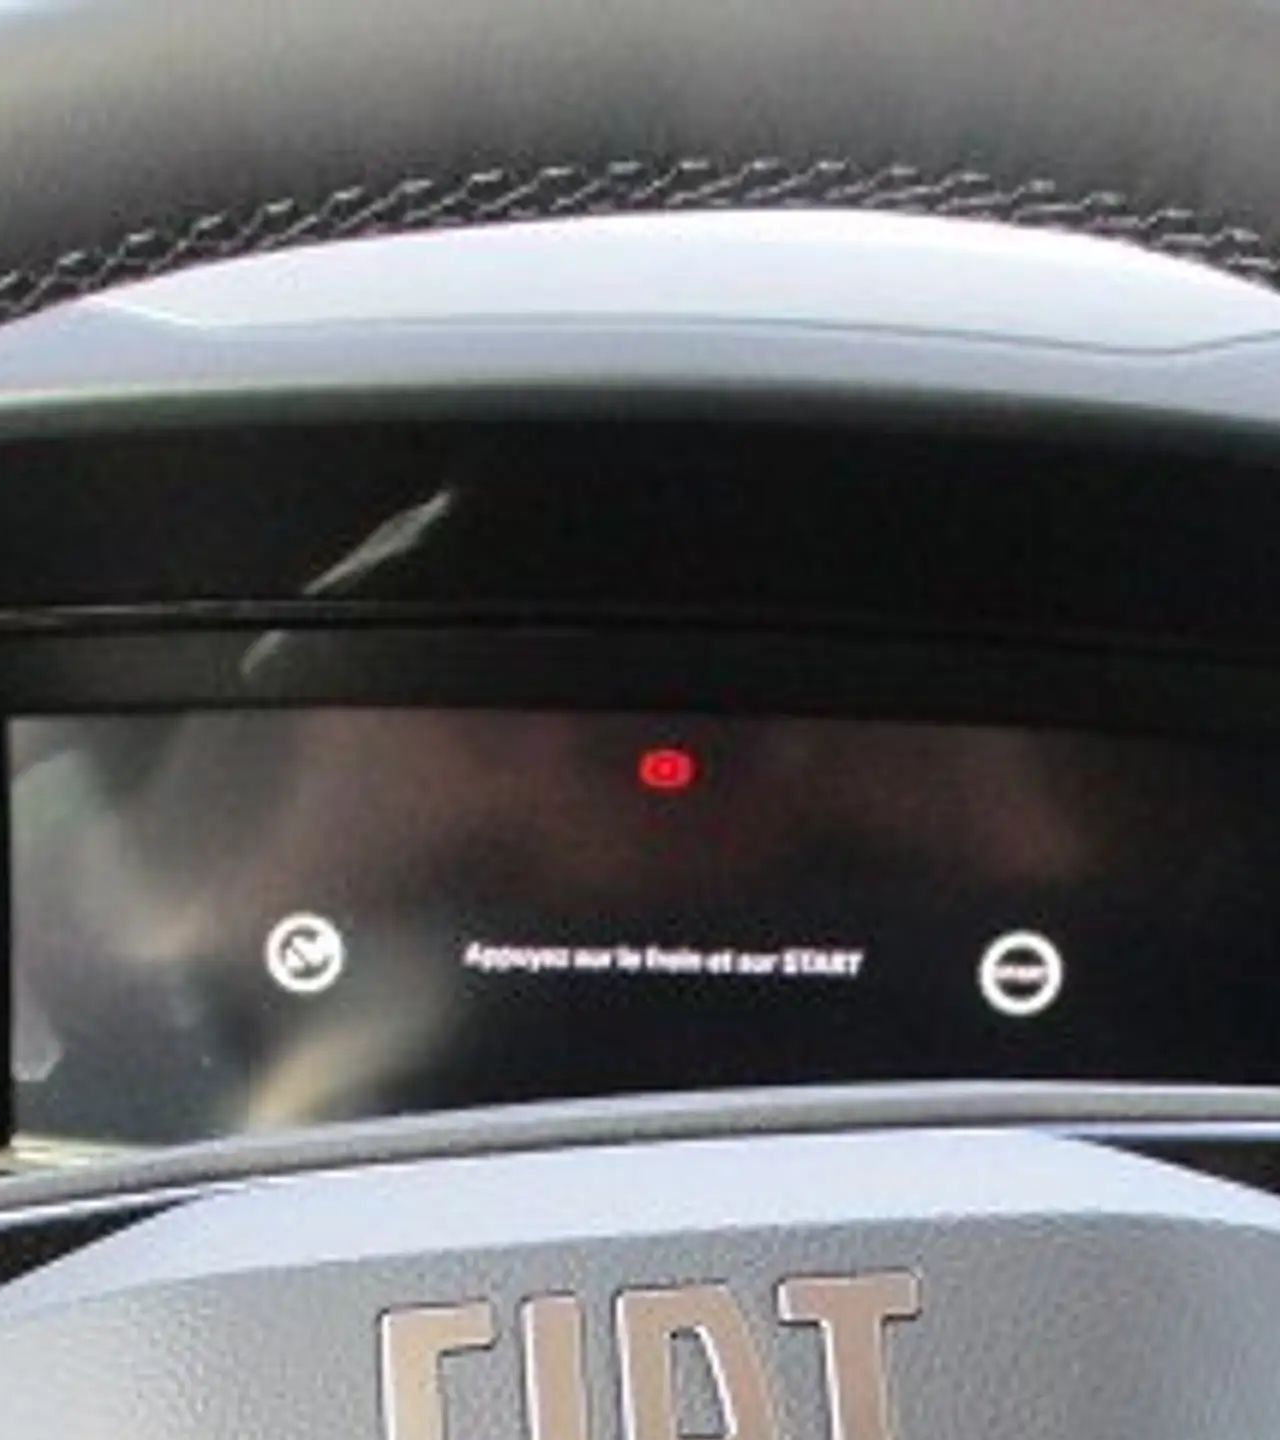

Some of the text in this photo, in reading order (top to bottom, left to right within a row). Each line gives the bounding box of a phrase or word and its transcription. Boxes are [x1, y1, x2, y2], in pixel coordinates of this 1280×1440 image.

[463, 941, 569, 973] Appuyez
[573, 946, 612, 970] sur
[616, 943, 642, 972] le
[705, 946, 732, 974] et
[736, 951, 779, 974] sur
[781, 947, 864, 976] START
